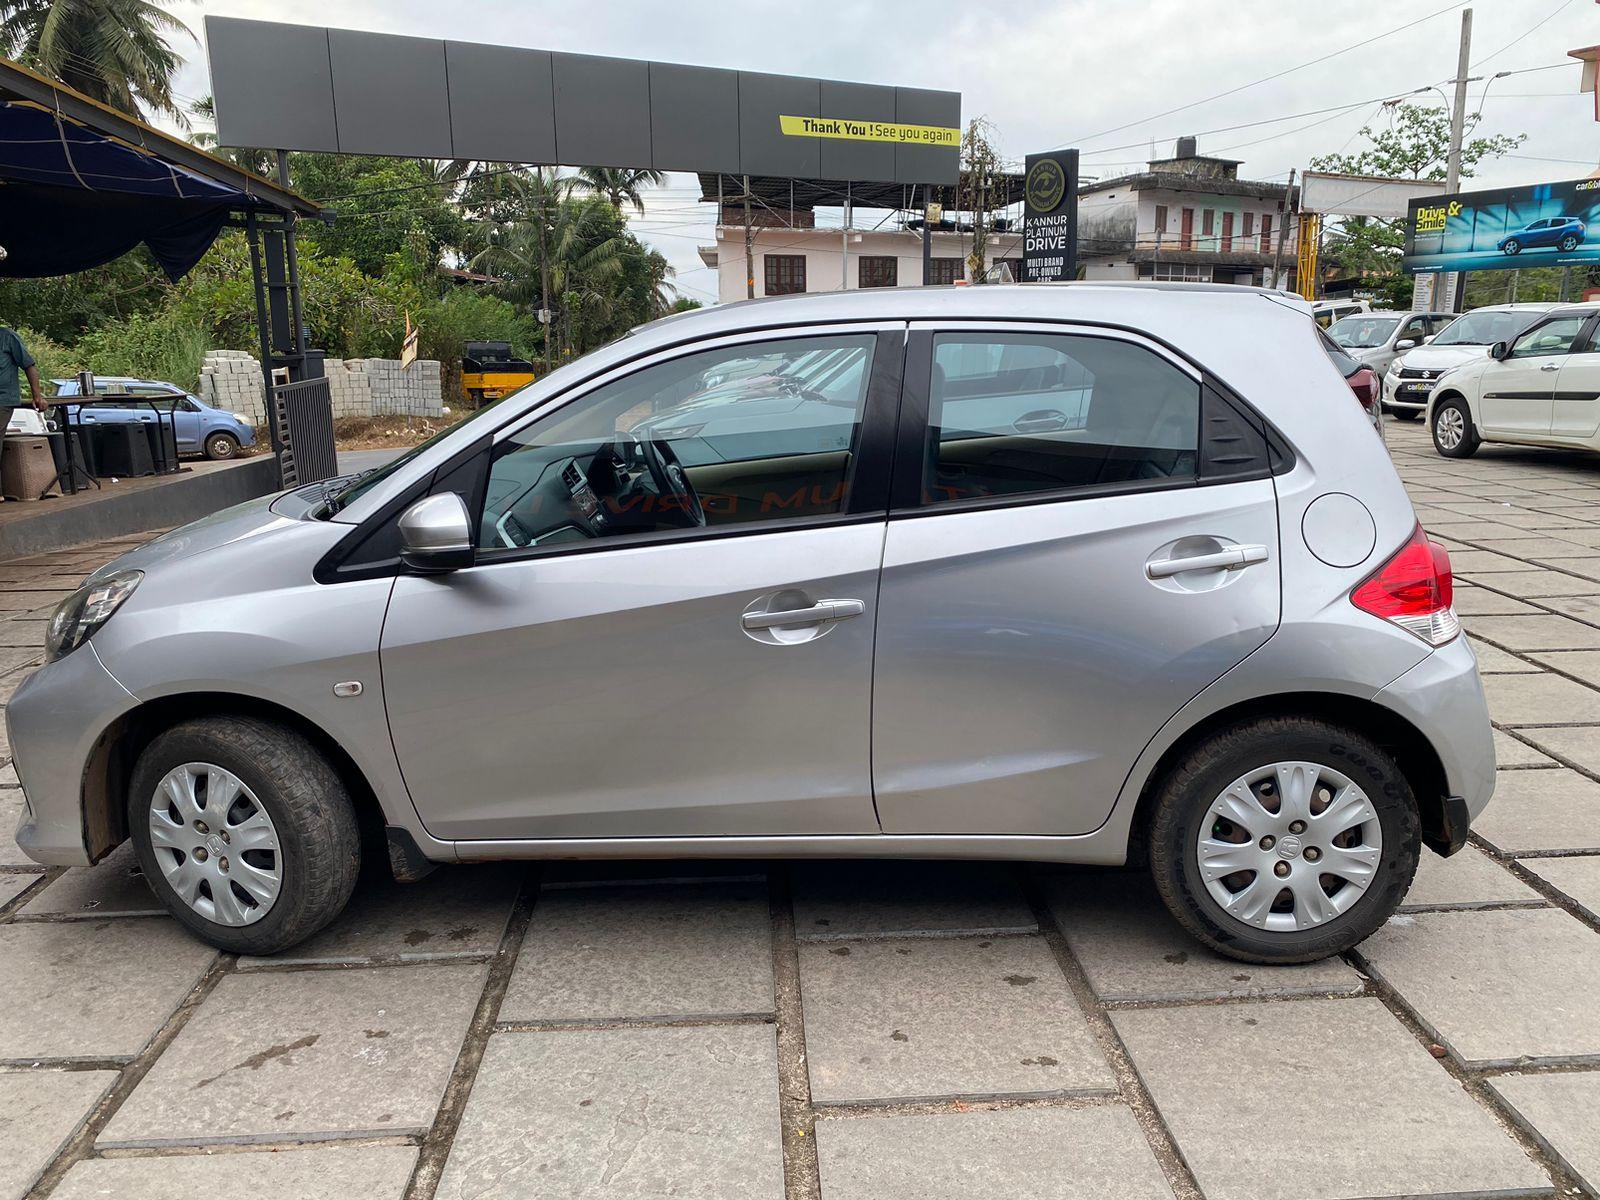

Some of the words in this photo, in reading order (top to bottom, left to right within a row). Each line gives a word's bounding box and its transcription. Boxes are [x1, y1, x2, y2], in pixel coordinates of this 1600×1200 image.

[803, 119, 840, 135] Thank
[844, 123, 866, 136] You
[899, 128, 920, 141] you
[922, 129, 952, 143] again
[1416, 205, 1446, 219] Drive
[1447, 200, 1463, 216] &
[1026, 215, 1068, 228] KANNUR
[1416, 217, 1446, 230] Smile
[1026, 226, 1067, 238] PLATINUM
[1026, 237, 1066, 251] DRIVE
[1027, 258, 1043, 268] MULTI
[1044, 257, 1064, 267] BRAND
[1028, 267, 1062, 277] PRE-OWNED
